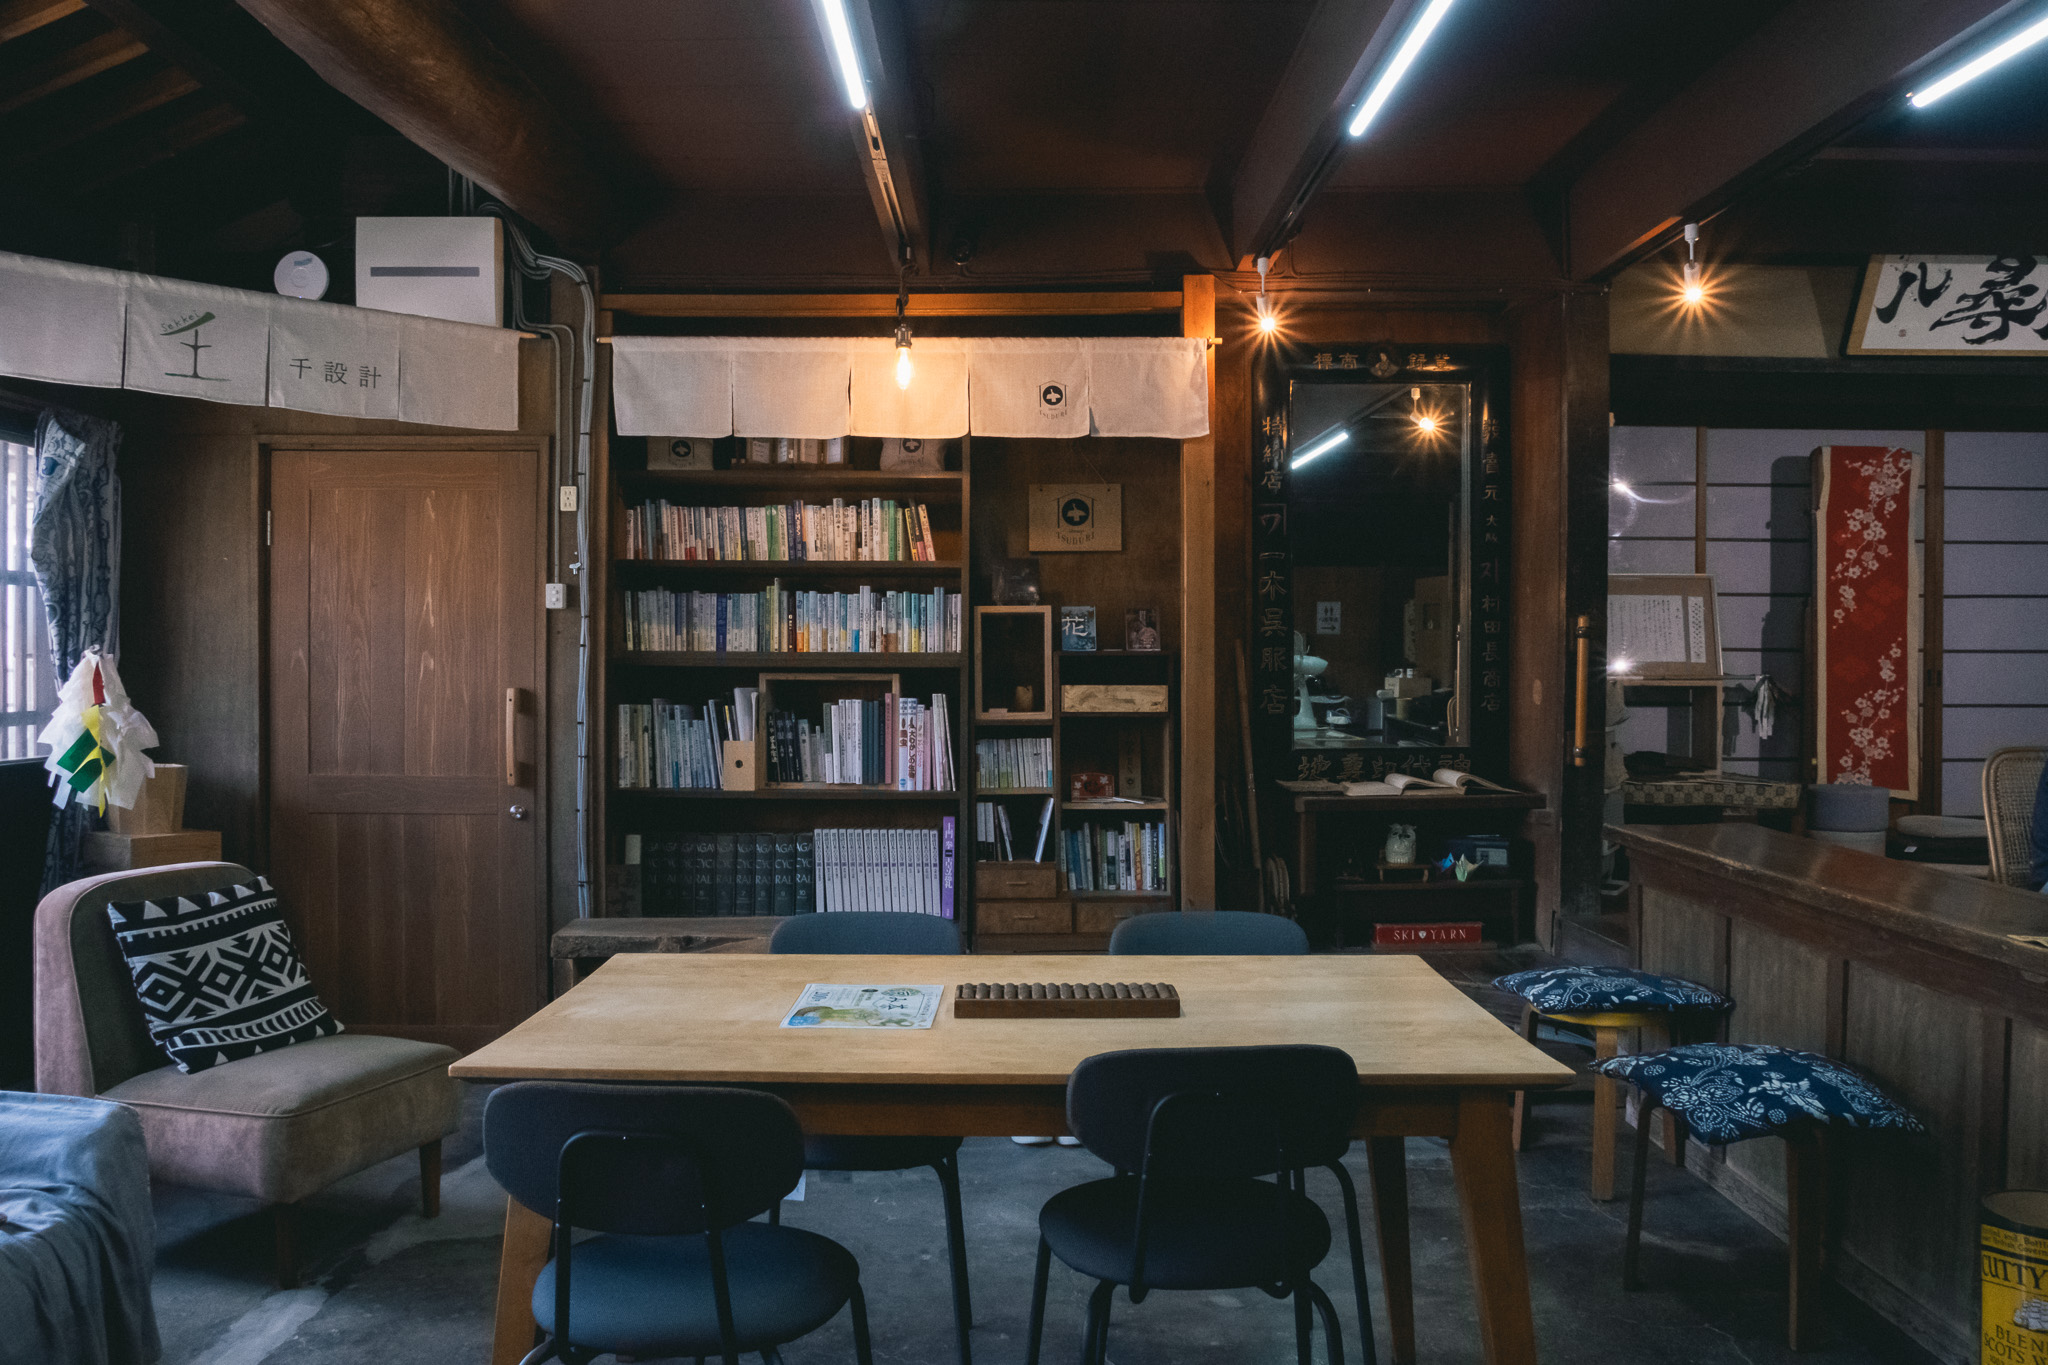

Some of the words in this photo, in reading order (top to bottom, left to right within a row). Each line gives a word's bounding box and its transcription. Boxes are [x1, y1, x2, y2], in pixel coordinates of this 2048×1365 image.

[160, 309, 199, 333] Sekkei
[289, 358, 382, 389] 千設計
[1061, 616, 1089, 637] 花
[1393, 930, 1415, 940] SKI
[1431, 929, 1467, 940] YARN
[2024, 1237, 2048, 1249] Bottl
[1982, 1254, 2048, 1291] CUTTY
[1984, 1332, 2025, 1364] SCOTS
[1995, 1324, 2048, 1353] BLEN
